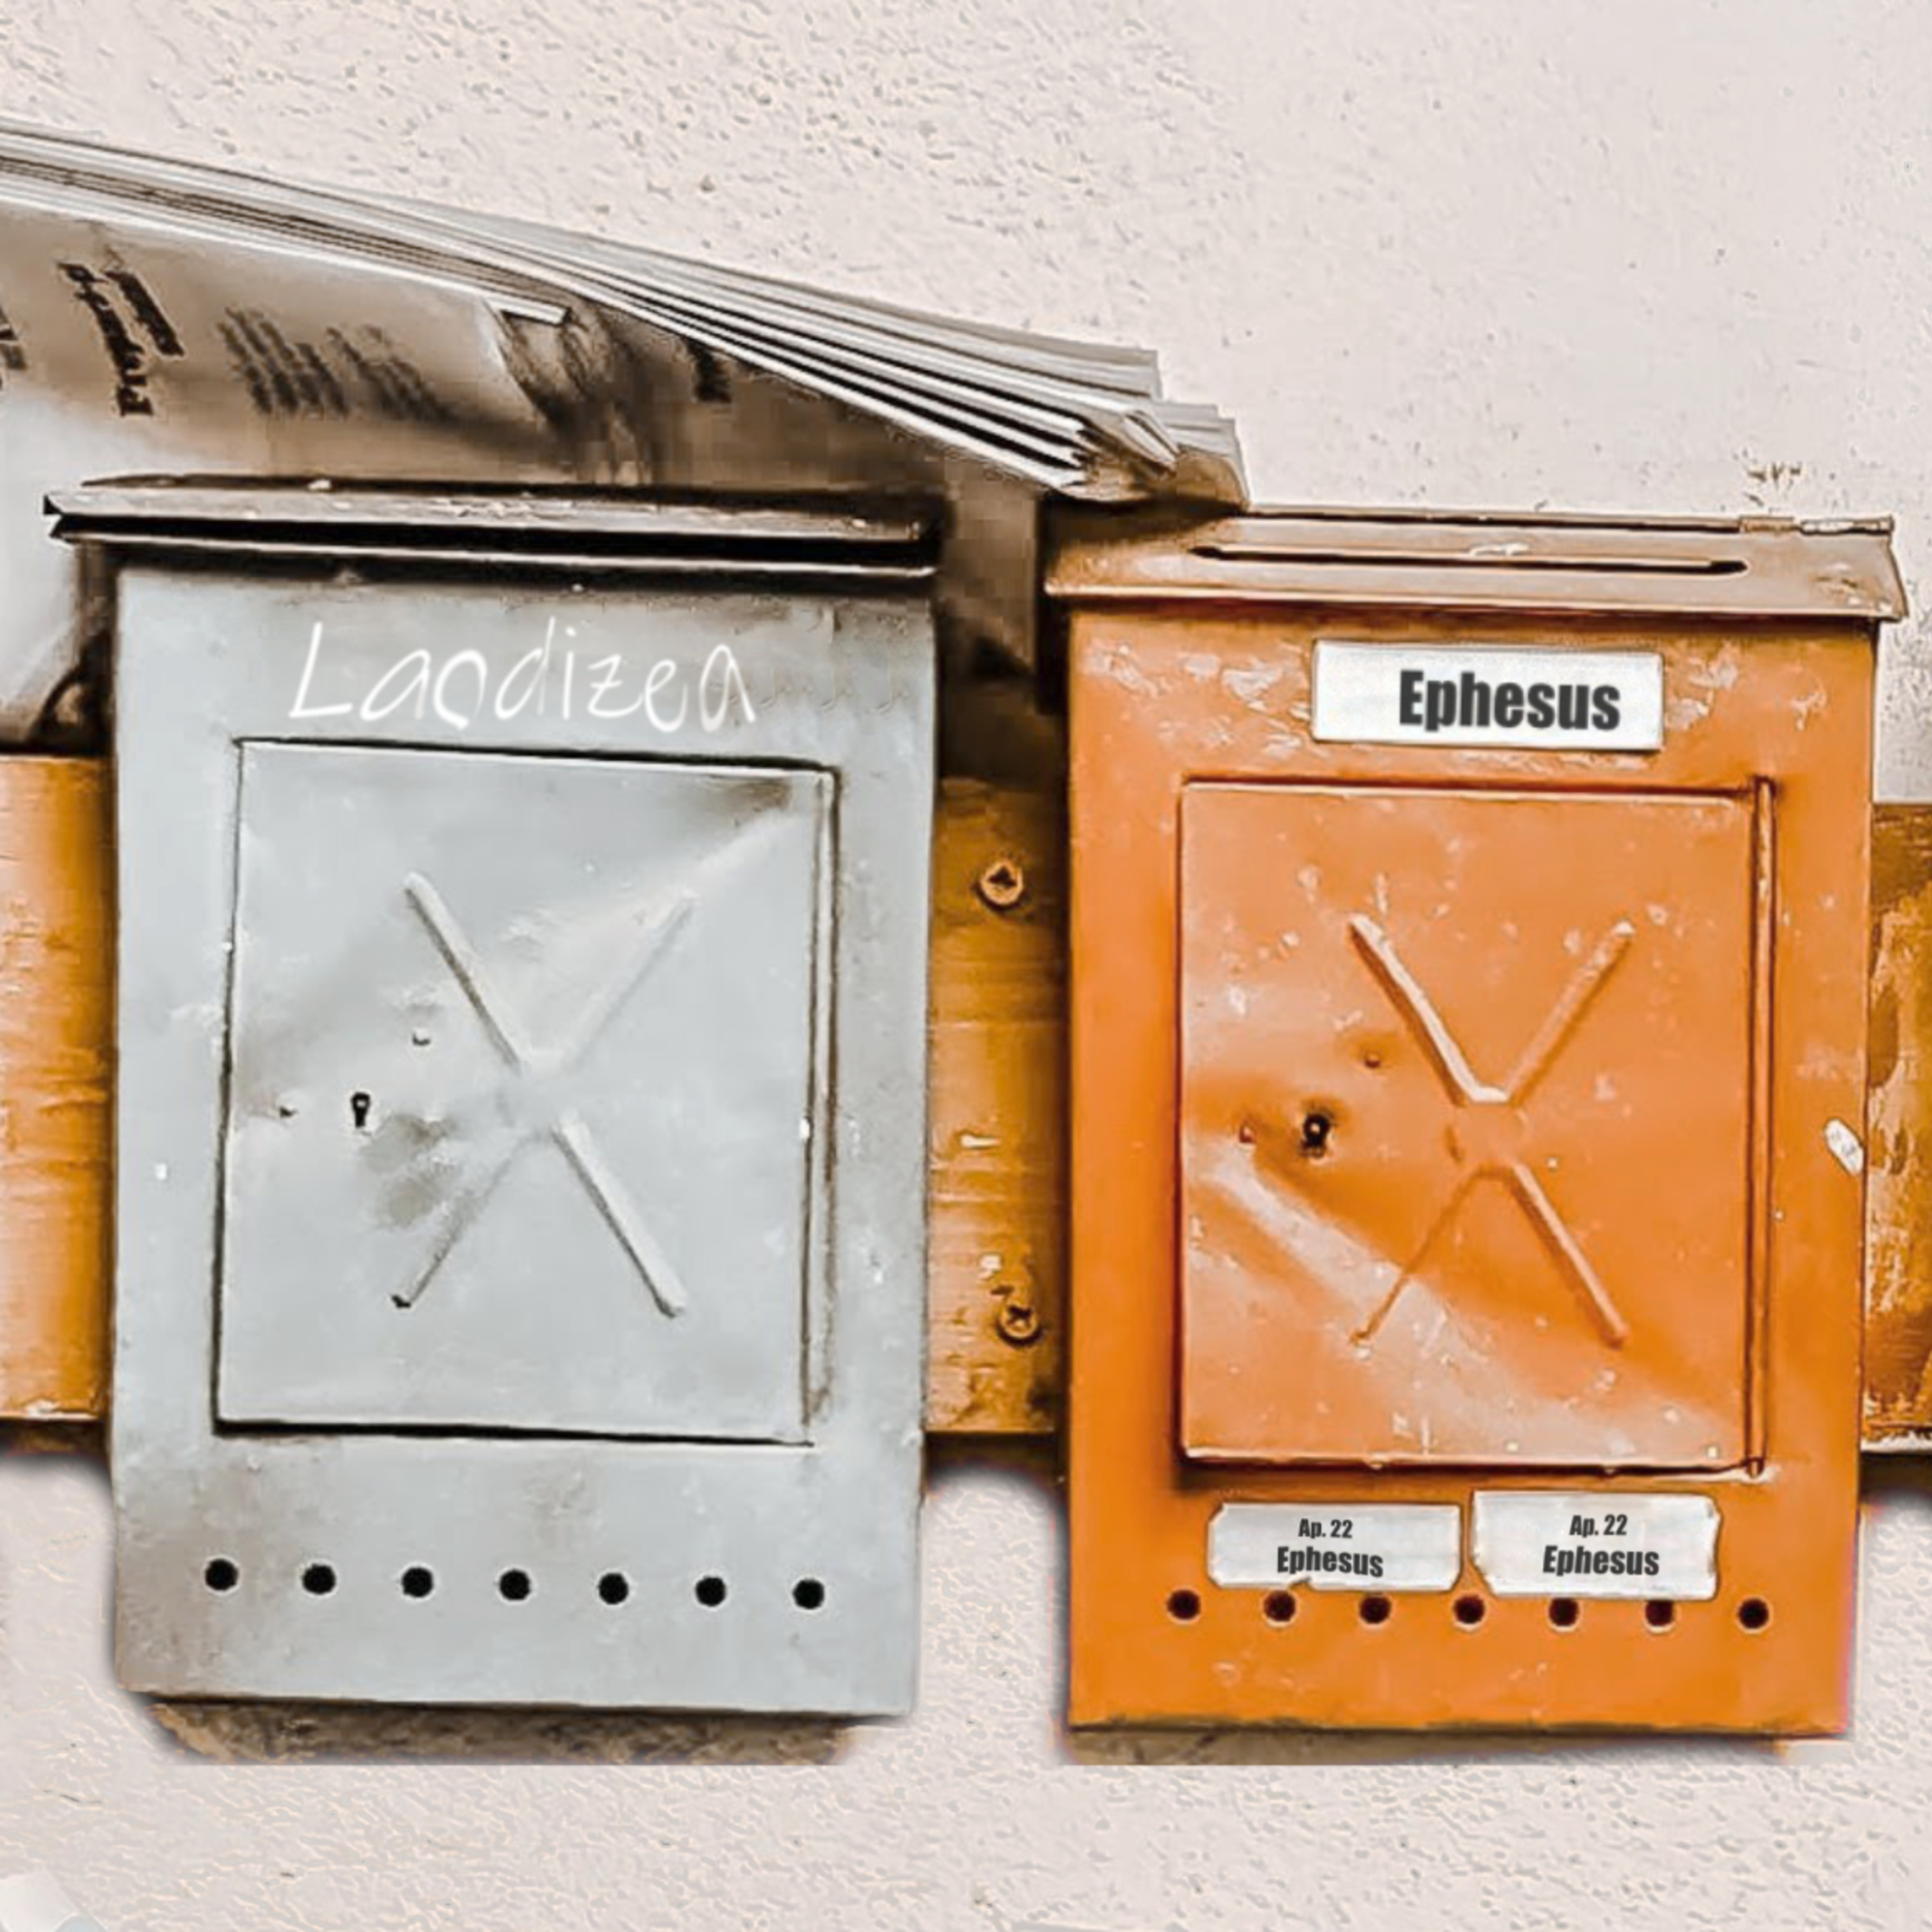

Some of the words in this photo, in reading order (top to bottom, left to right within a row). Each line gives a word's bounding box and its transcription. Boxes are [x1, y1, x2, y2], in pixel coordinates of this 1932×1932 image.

[1399, 669, 1621, 733] Ephesus
[1298, 1517, 1327, 1540] Ap.
[1330, 1519, 1354, 1539] 22
[1569, 1513, 1598, 1538] Ap.
[1603, 1513, 1628, 1536] 22
[1276, 1545, 1384, 1578] Ephesus
[1542, 1545, 1660, 1577] Ephesus
